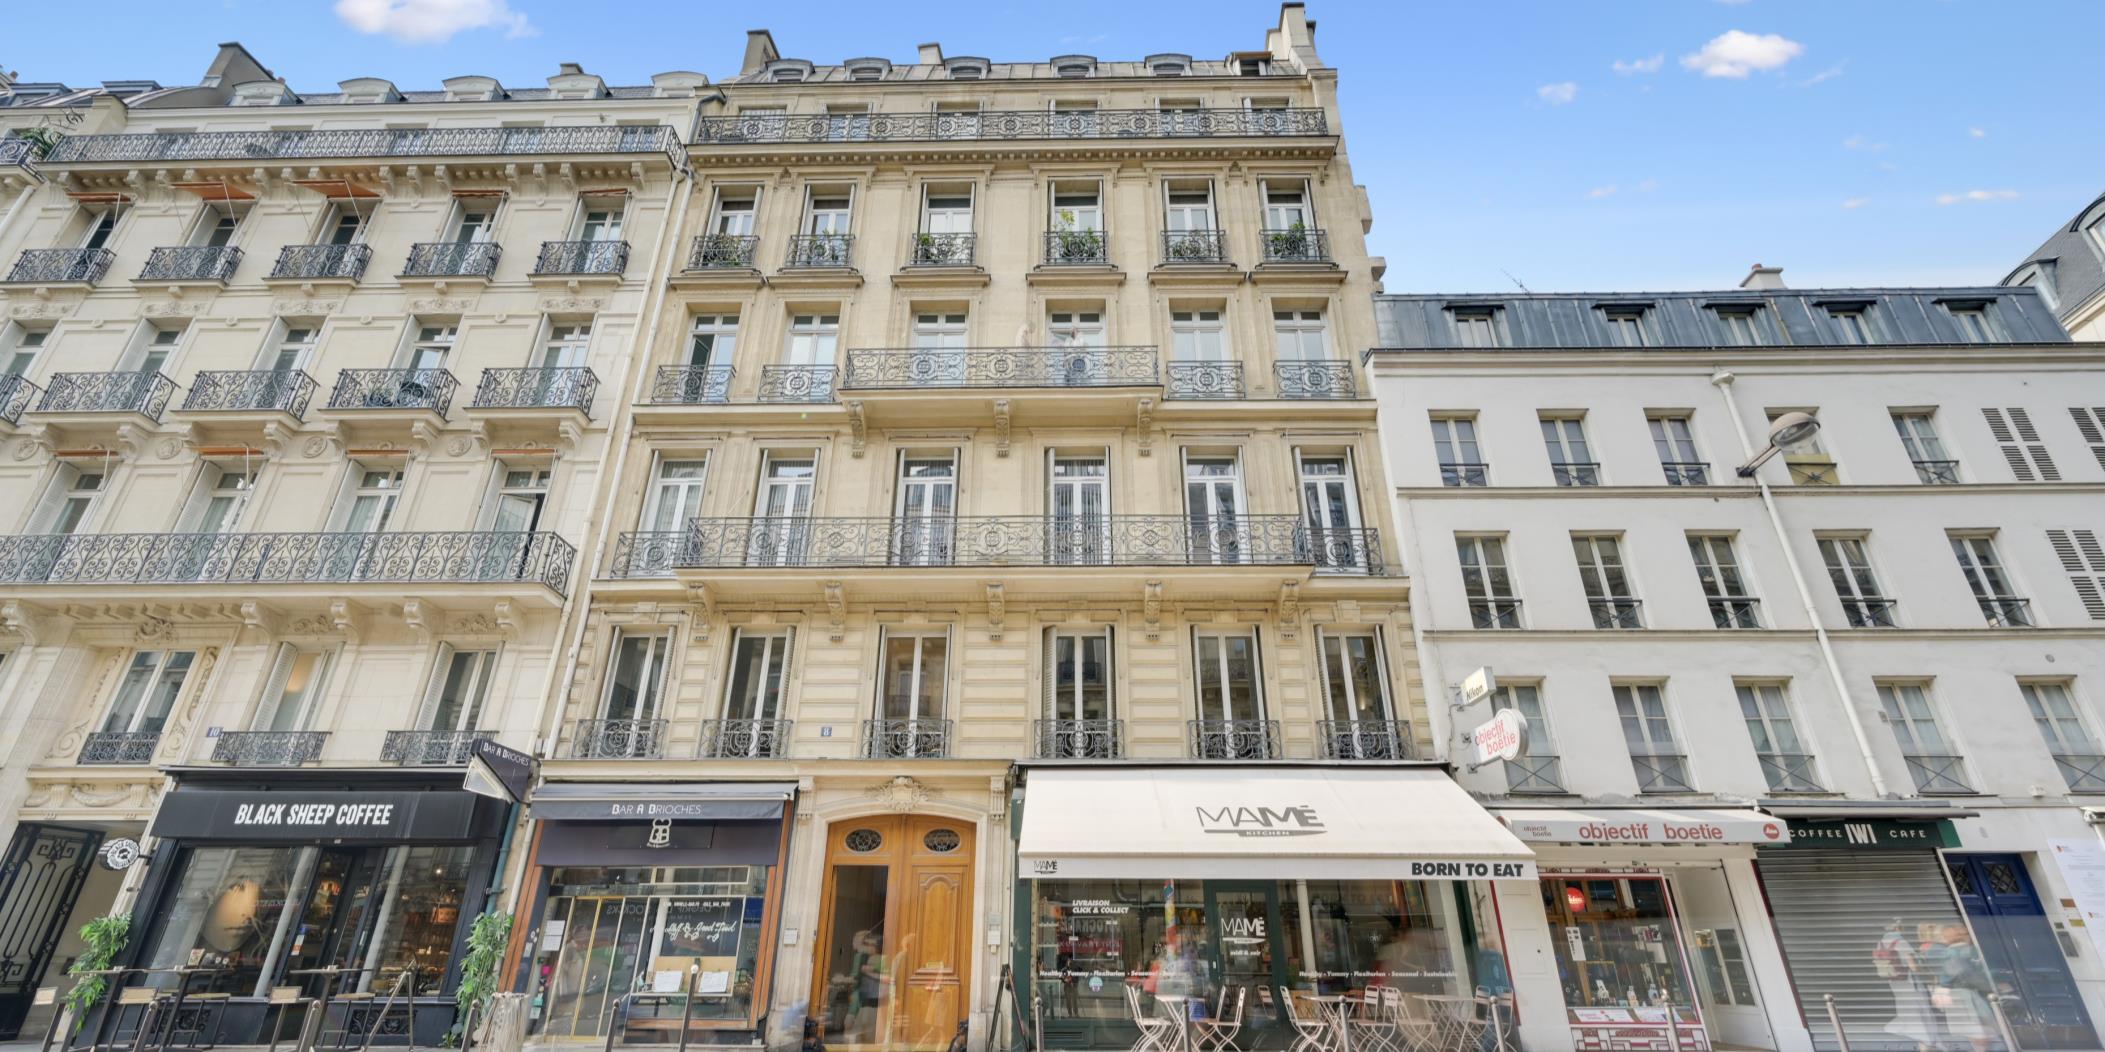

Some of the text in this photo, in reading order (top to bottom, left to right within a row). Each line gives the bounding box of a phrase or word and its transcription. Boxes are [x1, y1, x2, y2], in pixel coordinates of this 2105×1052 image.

[1466, 684, 1483, 700] Nikon
[1475, 720, 1504, 746] objectif
[234, 804, 394, 825] BLACK SHEEP COFFEE
[636, 804, 644, 814] A
[1579, 823, 1723, 840] objectif boetie
[1789, 829, 1843, 838] COFFEE
[1889, 830, 1926, 838] CAFE
[1411, 862, 1523, 877] BORN TO EAT
[1039, 970, 1062, 978] Healthy
[1067, 970, 1089, 978] Yummy
